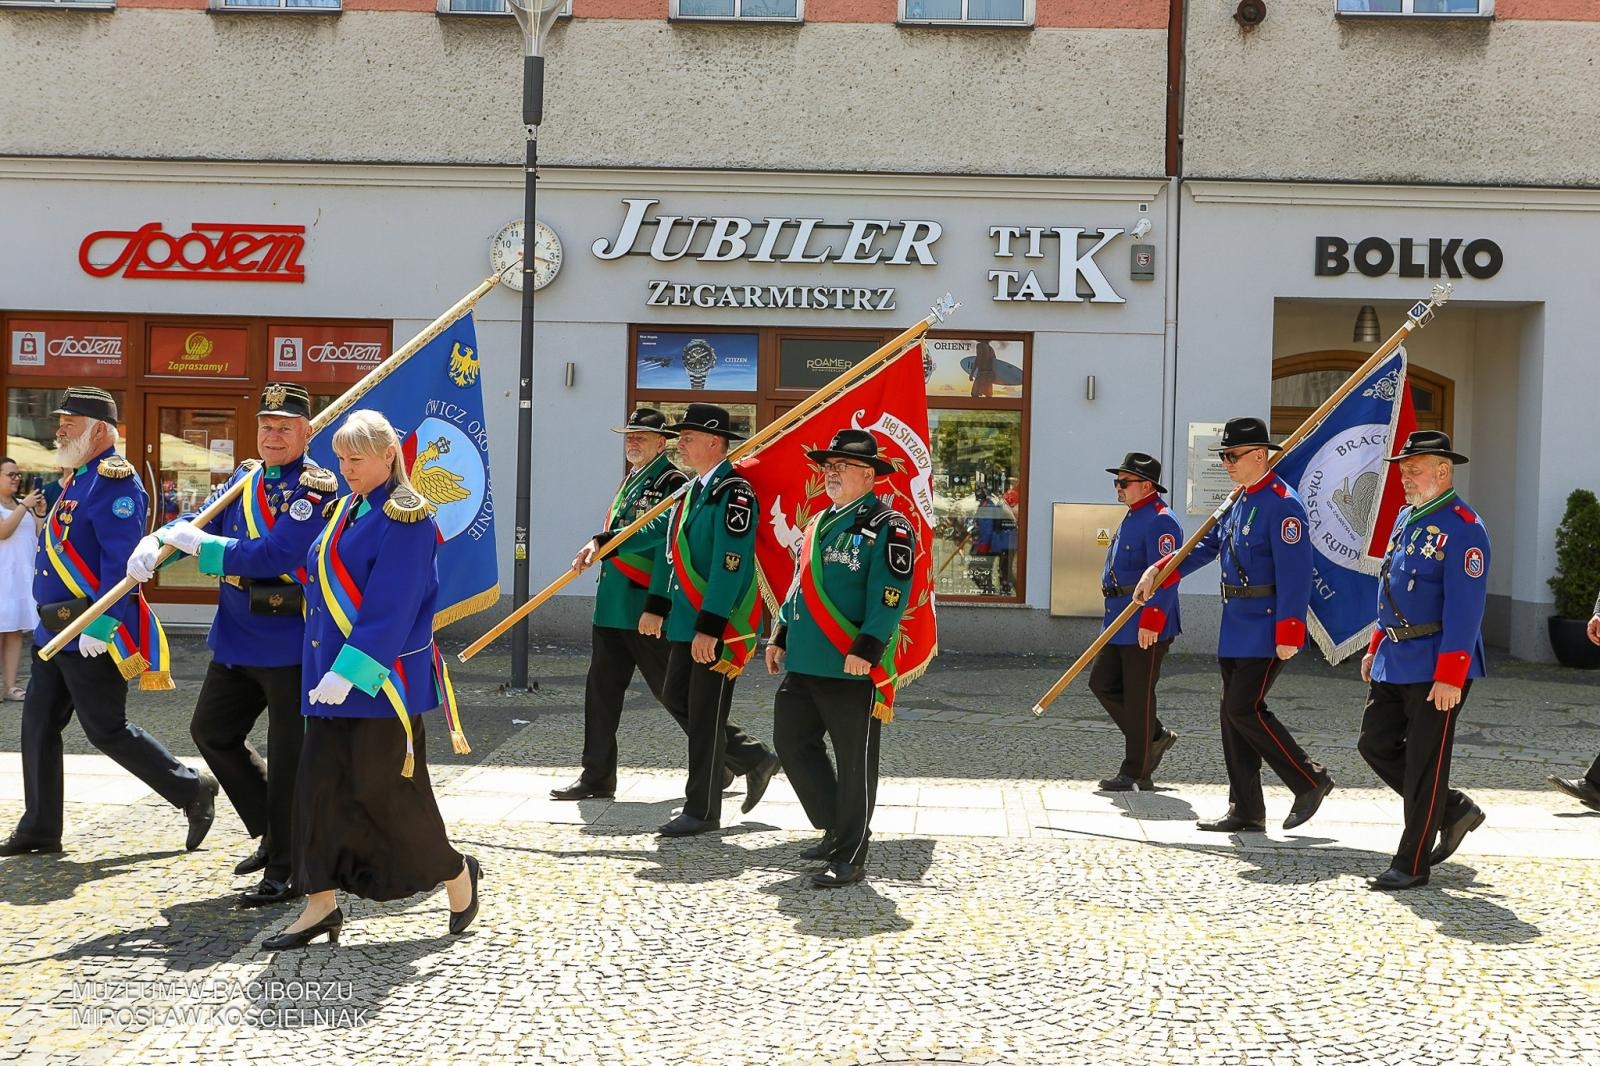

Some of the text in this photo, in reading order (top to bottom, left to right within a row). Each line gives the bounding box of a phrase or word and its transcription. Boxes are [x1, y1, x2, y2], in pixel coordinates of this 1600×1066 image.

[591, 198, 943, 265] JUBILER
[1315, 236, 1503, 279] BOLKO
[645, 279, 896, 311] ZEGARMISTRZ
[806, 358, 852, 369] ROAMER
[934, 342, 971, 351] ORIENT
[882, 416, 899, 436] Hej
[896, 428, 930, 469] Strzelcy
